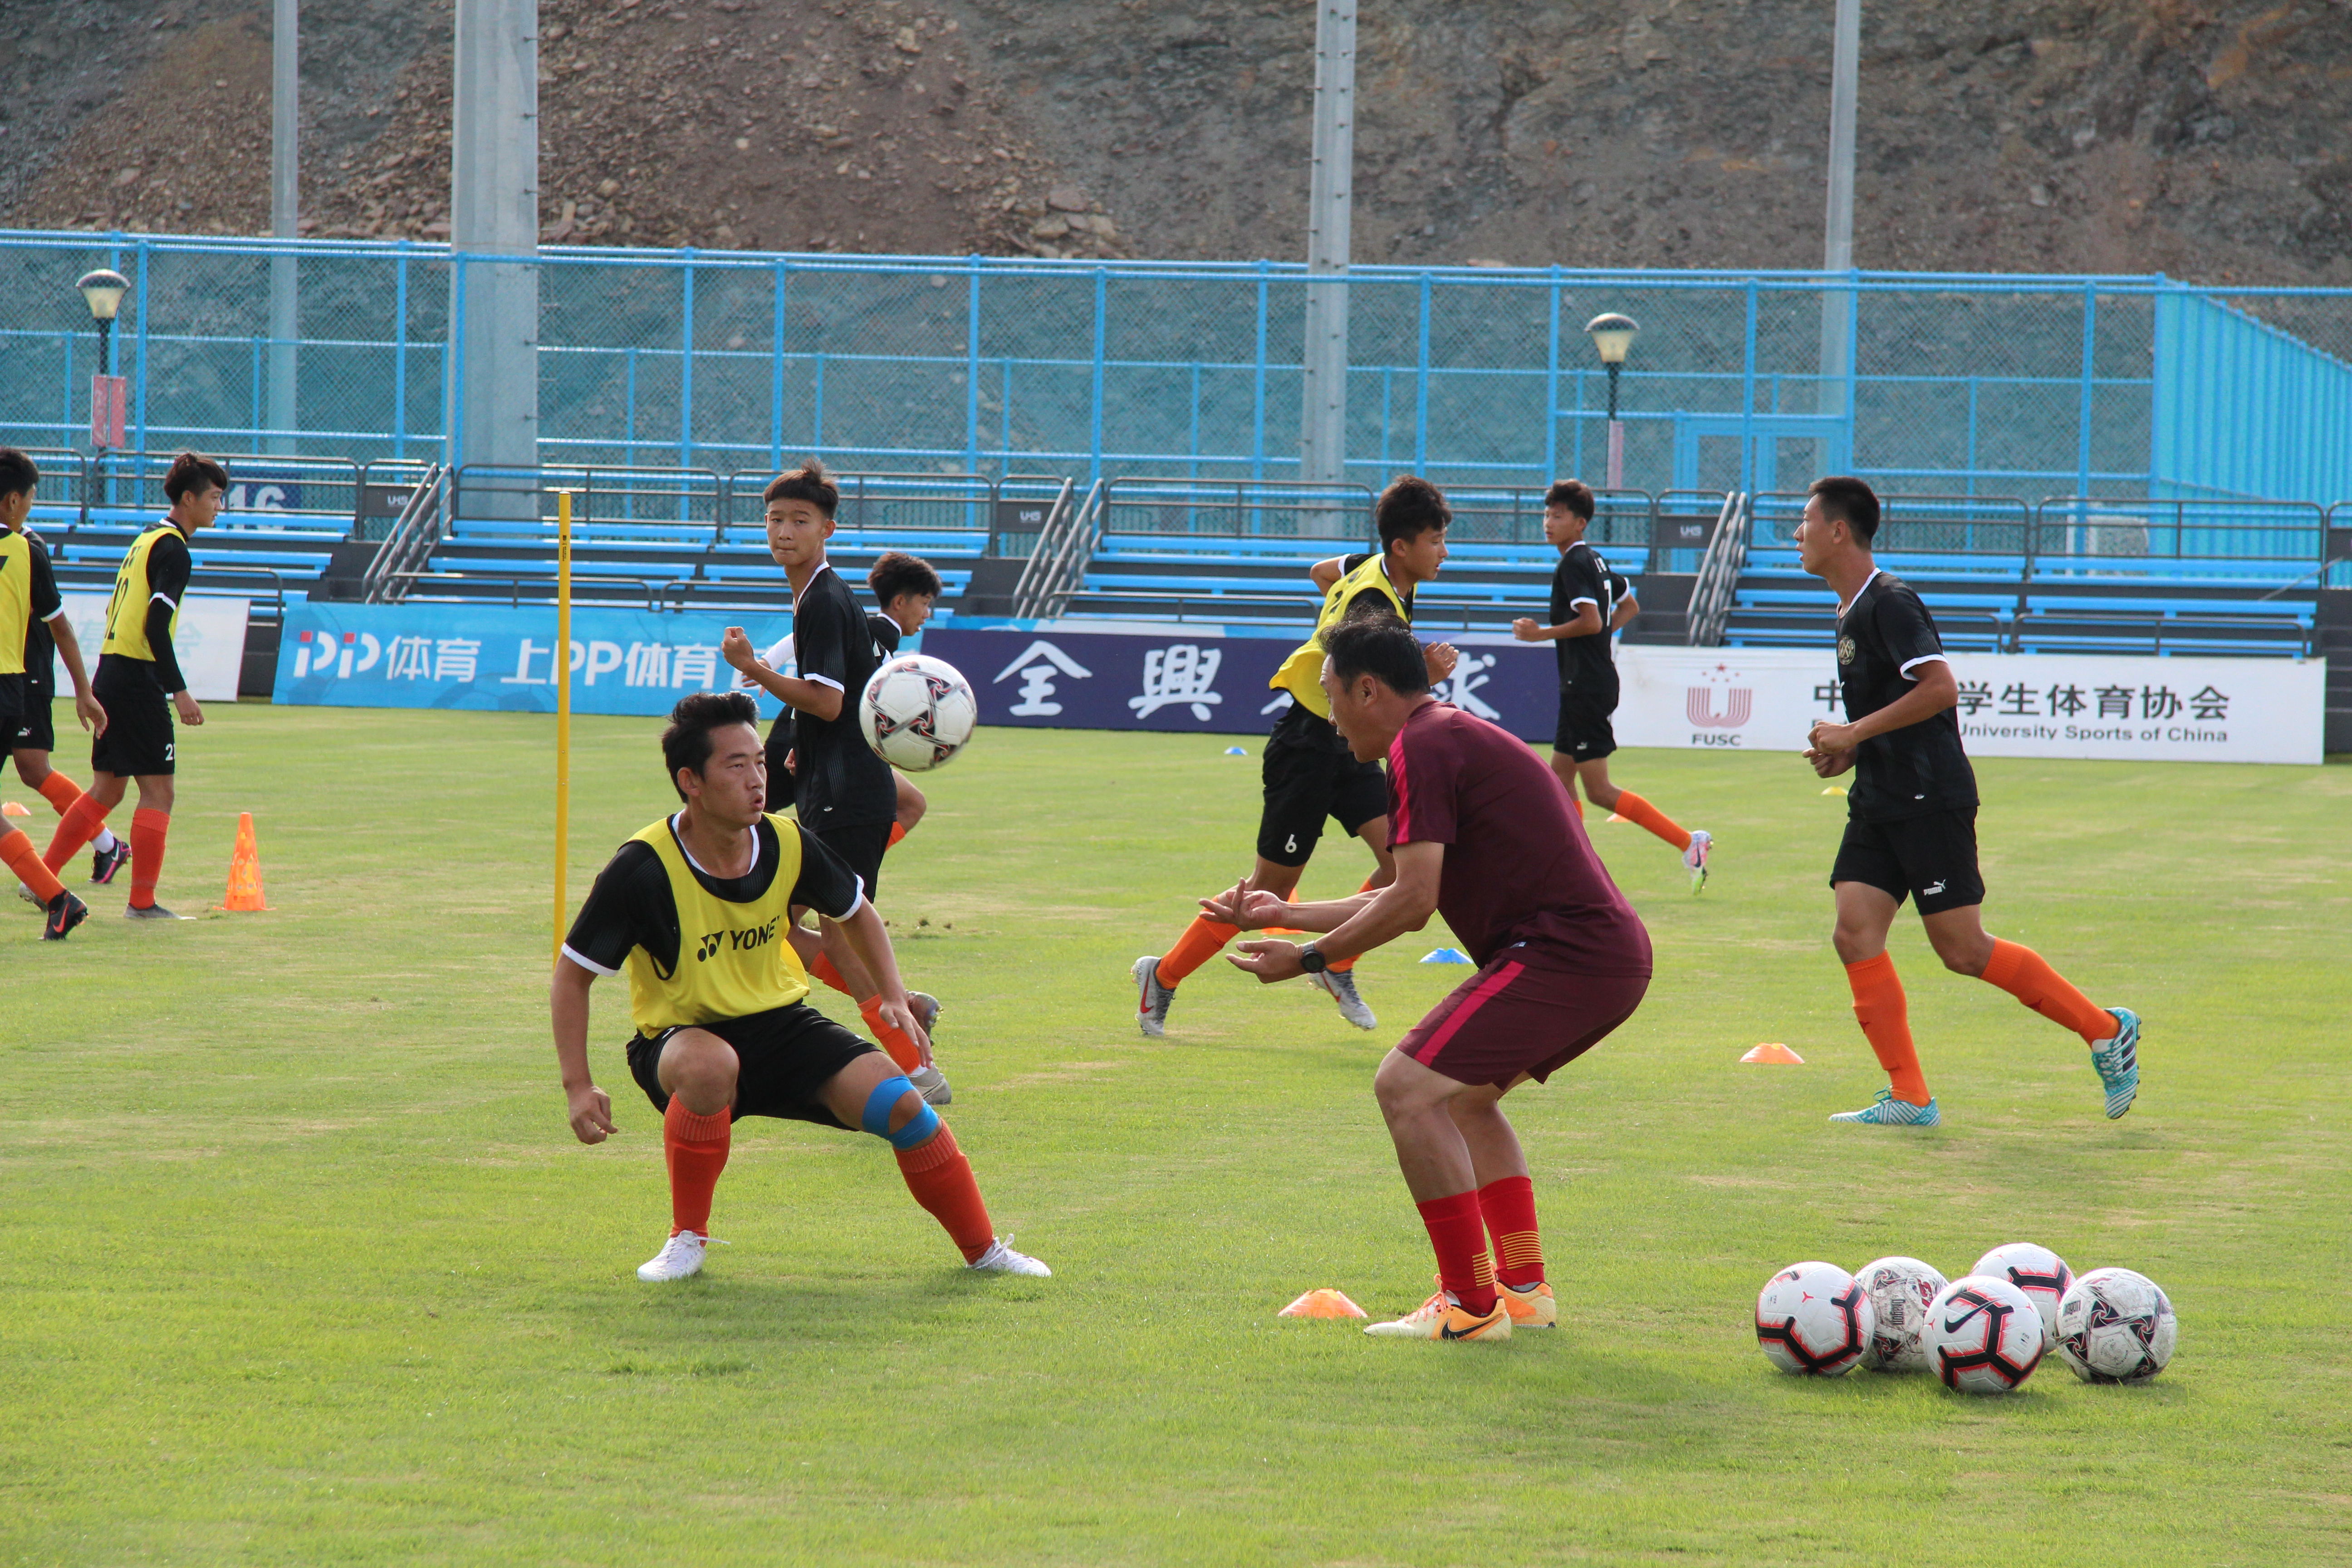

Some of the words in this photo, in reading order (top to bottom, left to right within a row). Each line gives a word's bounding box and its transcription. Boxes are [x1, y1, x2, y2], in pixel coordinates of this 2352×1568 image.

[1814, 679, 2230, 720] 中学生体育协会
[1692, 733, 1741, 745] FUSC
[2065, 725, 2133, 741] Sports
[2140, 727, 2160, 741] of
[2167, 728, 2228, 742] China
[1284, 833, 1297, 853] 6
[729, 915, 780, 951] YONE
[1890, 1298, 1906, 1325] Dragon
